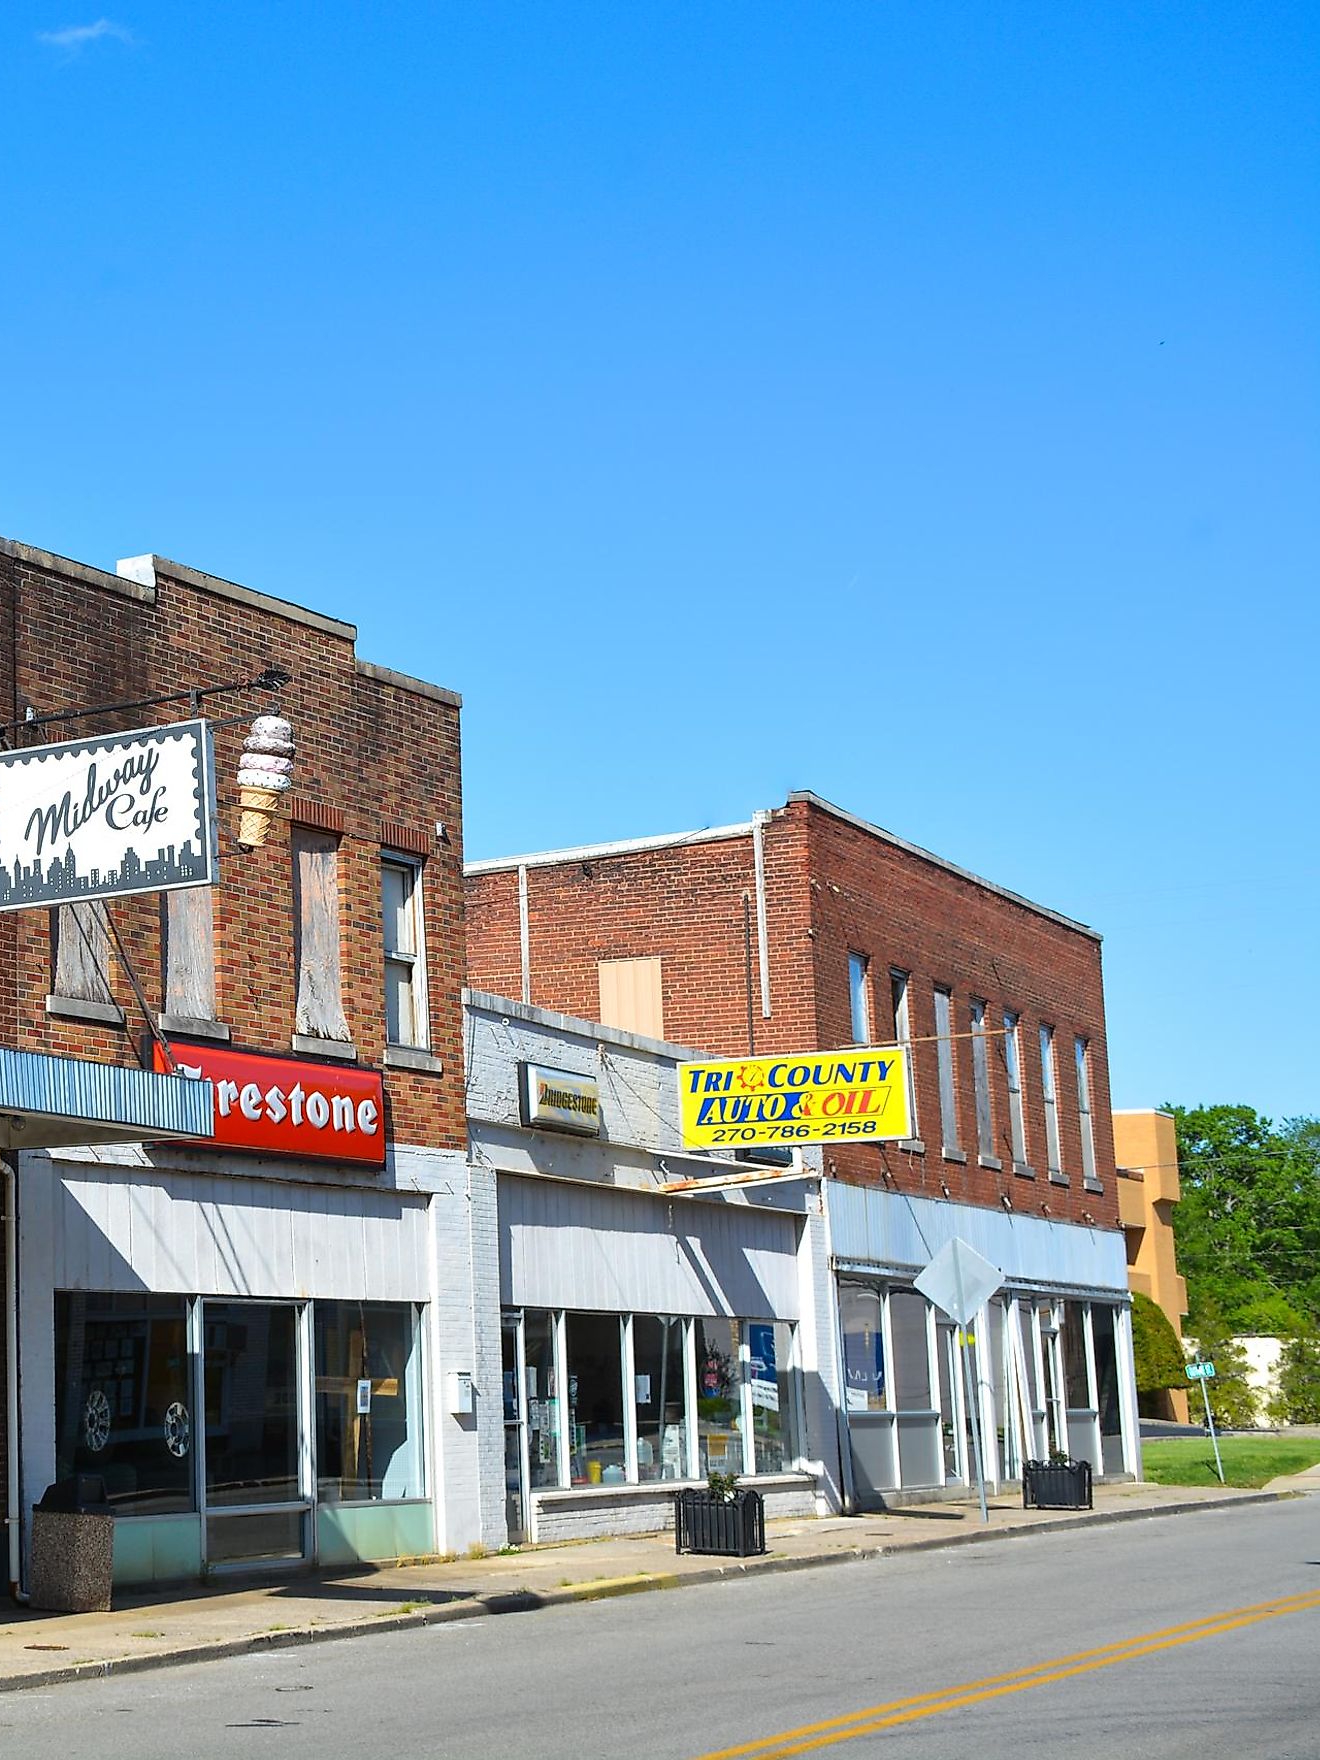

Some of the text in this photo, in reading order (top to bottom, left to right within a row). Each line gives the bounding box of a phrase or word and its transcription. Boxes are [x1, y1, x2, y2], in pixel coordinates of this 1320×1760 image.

[24, 748, 160, 856] Midway
[105, 786, 169, 835] Cafe
[689, 1059, 895, 1094] TRI COUNTY
[539, 1082, 598, 1115] BRIDGESTONE
[701, 1094, 786, 1124] AUTO
[822, 1089, 882, 1116] OIL
[712, 1121, 877, 1143] 270-786-2158
